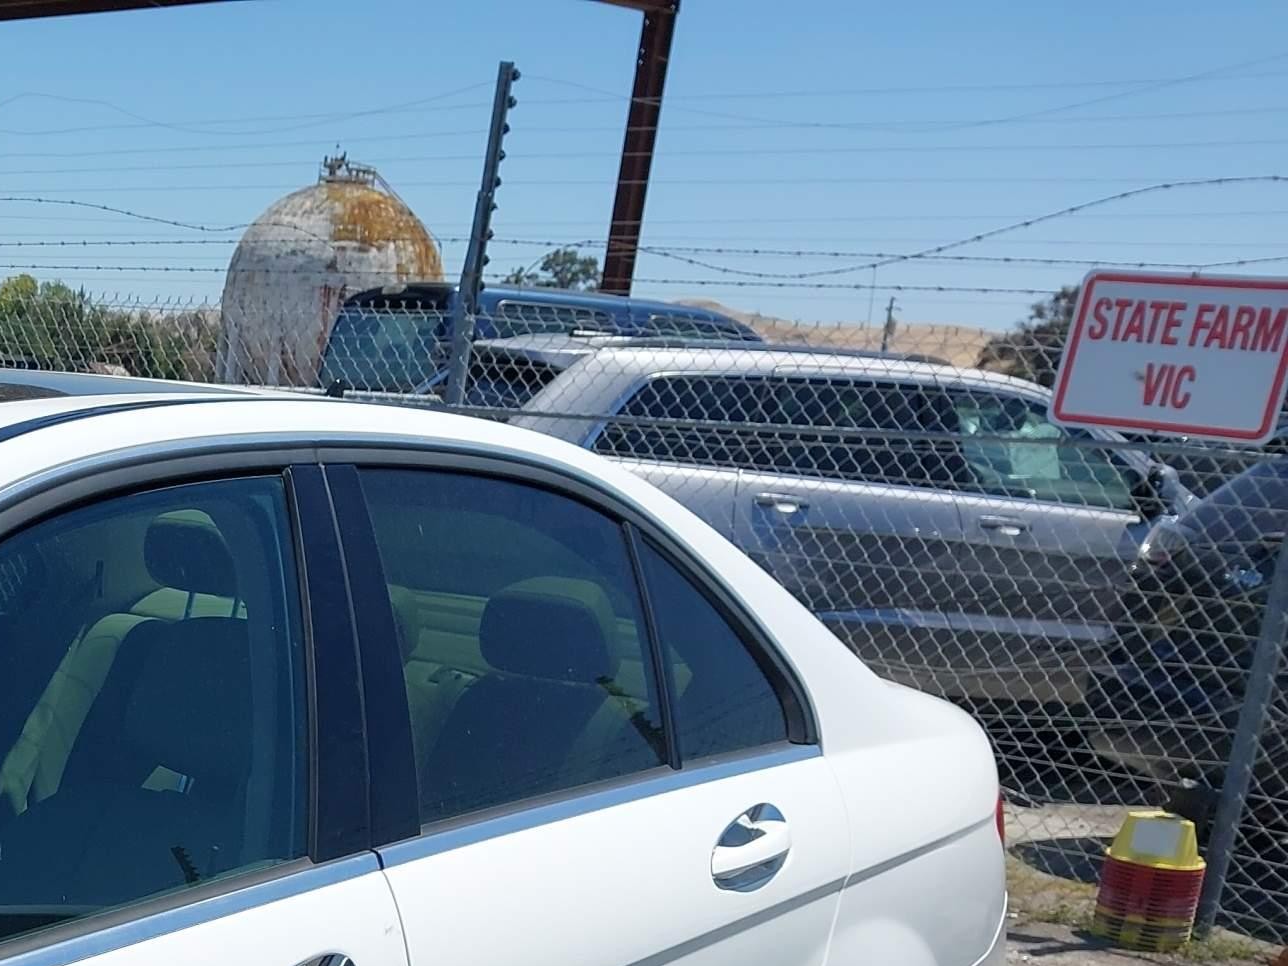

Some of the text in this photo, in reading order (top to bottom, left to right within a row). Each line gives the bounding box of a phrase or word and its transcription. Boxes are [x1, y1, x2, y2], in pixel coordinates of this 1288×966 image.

[1088, 297, 1288, 352] STATE FARM
[1143, 362, 1196, 409] VIC
